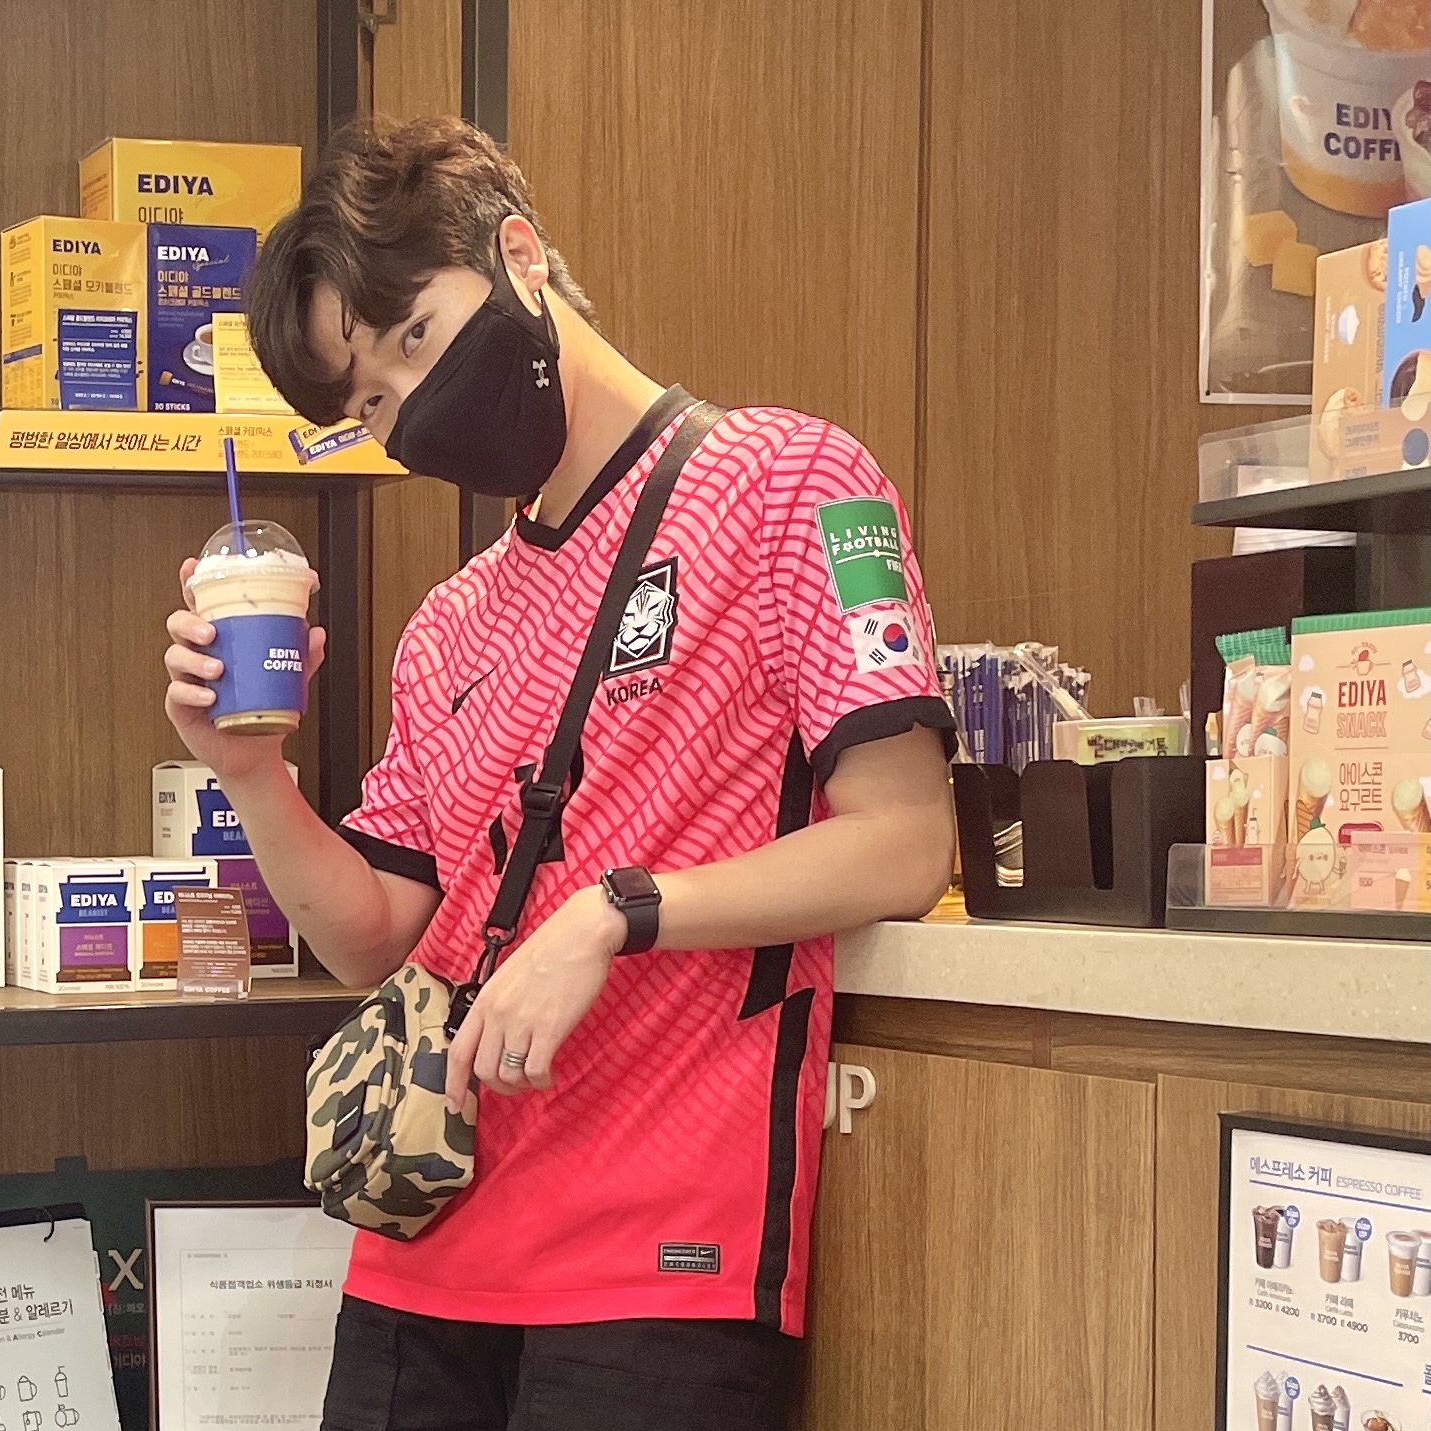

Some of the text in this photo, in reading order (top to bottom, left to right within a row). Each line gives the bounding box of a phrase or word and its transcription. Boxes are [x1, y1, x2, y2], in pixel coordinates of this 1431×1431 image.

[138, 174, 213, 195] EDIYA
[138, 206, 184, 224] 이디야
[52, 239, 101, 255] EDIYA
[157, 246, 209, 262] EDIYA
[52, 264, 82, 277] 이디야
[157, 271, 189, 283] 이디야
[52, 279, 82, 291] 스페셜
[157, 287, 188, 299] 스페셜
[9, 431, 54, 449] 평범한
[55, 432, 113, 450] 일상에서
[114, 433, 170, 451] 벗어나는
[171, 434, 201, 451] 시간
[830, 525, 897, 544] LIVING
[269, 648, 300, 660] EDIYA
[263, 660, 303, 672] COFFEE
[606, 678, 664, 706] KOREA
[1338, 679, 1387, 708] EDIYA
[1337, 711, 1387, 738] SNACK
[1339, 761, 1383, 785] 아이스콘
[1339, 788, 1383, 811] 요구르트
[70, 893, 118, 907] EDIYA
[1249, 1156, 1422, 1200] 에스프레소 커피 ESPRESSO COFFEE
[11, 1283, 36, 1301] 메뉴
[210, 1279, 333, 1289] 식품접객업소 위생등급 지정서
[13, 1307, 23, 1322] &
[25, 1299, 74, 1321] 알레르기
